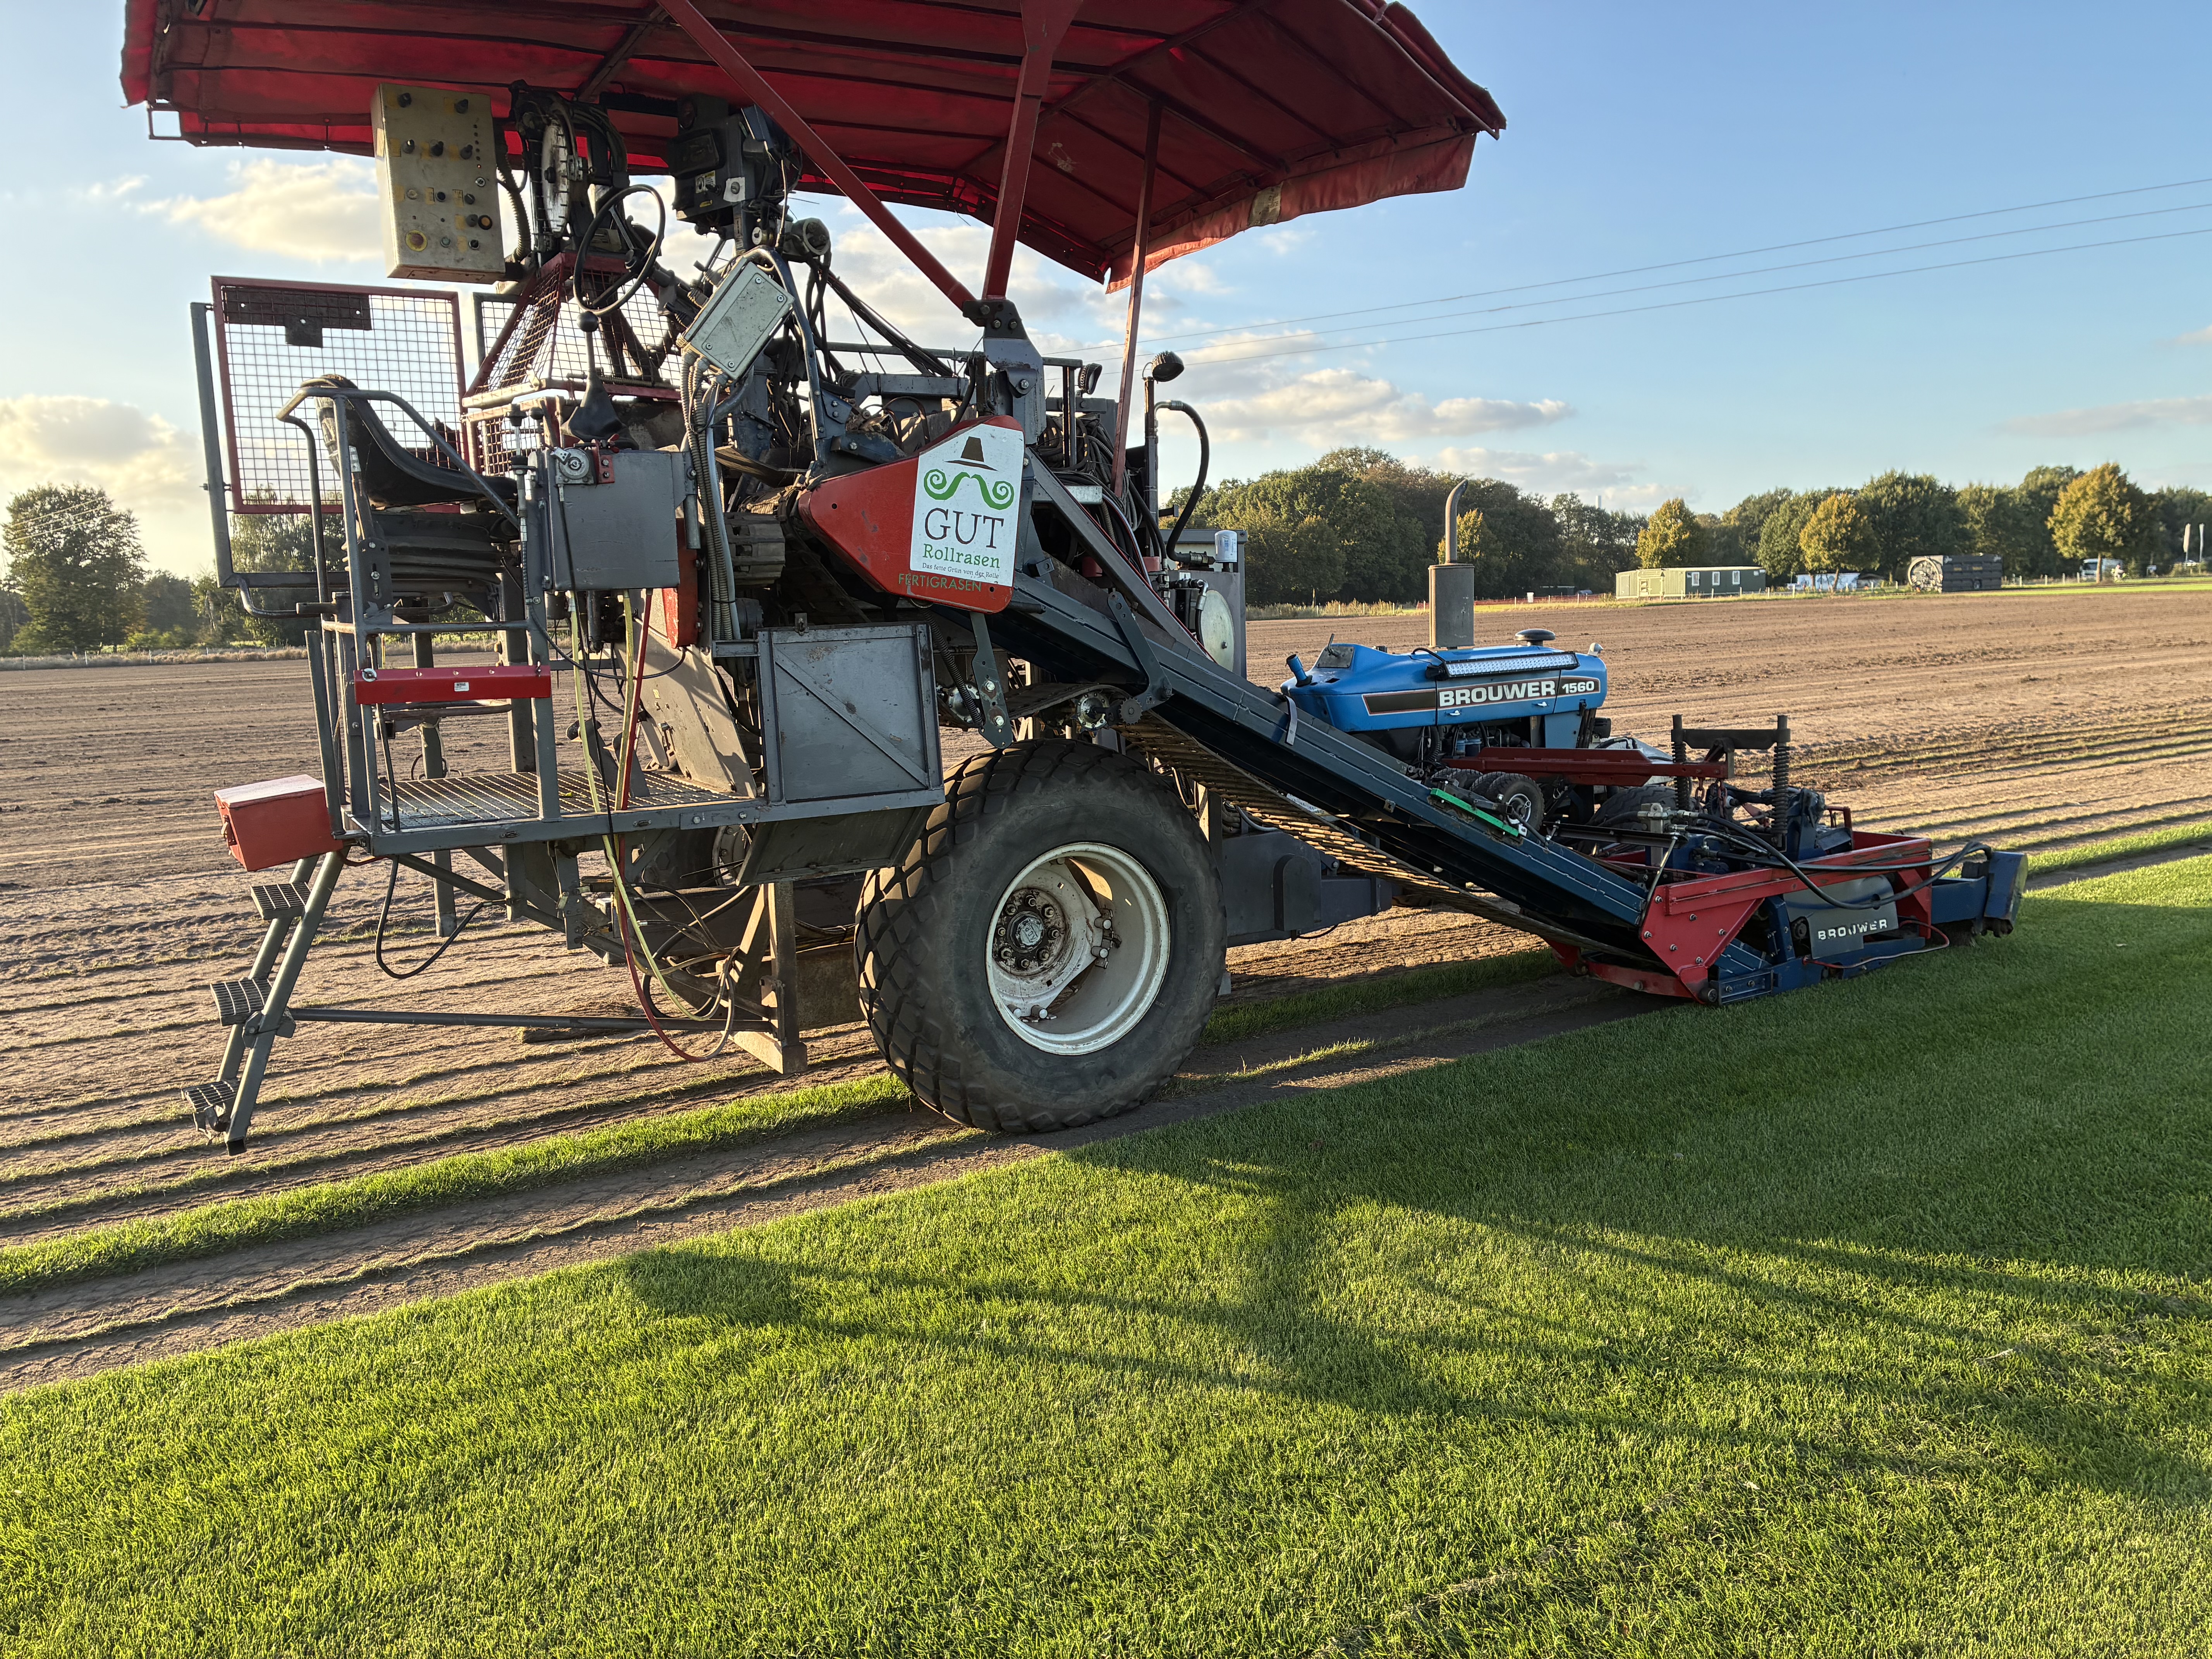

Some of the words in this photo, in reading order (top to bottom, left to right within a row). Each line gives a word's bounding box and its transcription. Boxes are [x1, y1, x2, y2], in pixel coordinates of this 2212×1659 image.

[924, 507, 1004, 549] GUT
[922, 543, 1000, 568] Rollrasen
[898, 573, 981, 592] FERTIGRASEN
[1439, 680, 1555, 707] BROUWER
[1561, 680, 1595, 694] 1560
[1818, 919, 1887, 940] BROUWER
